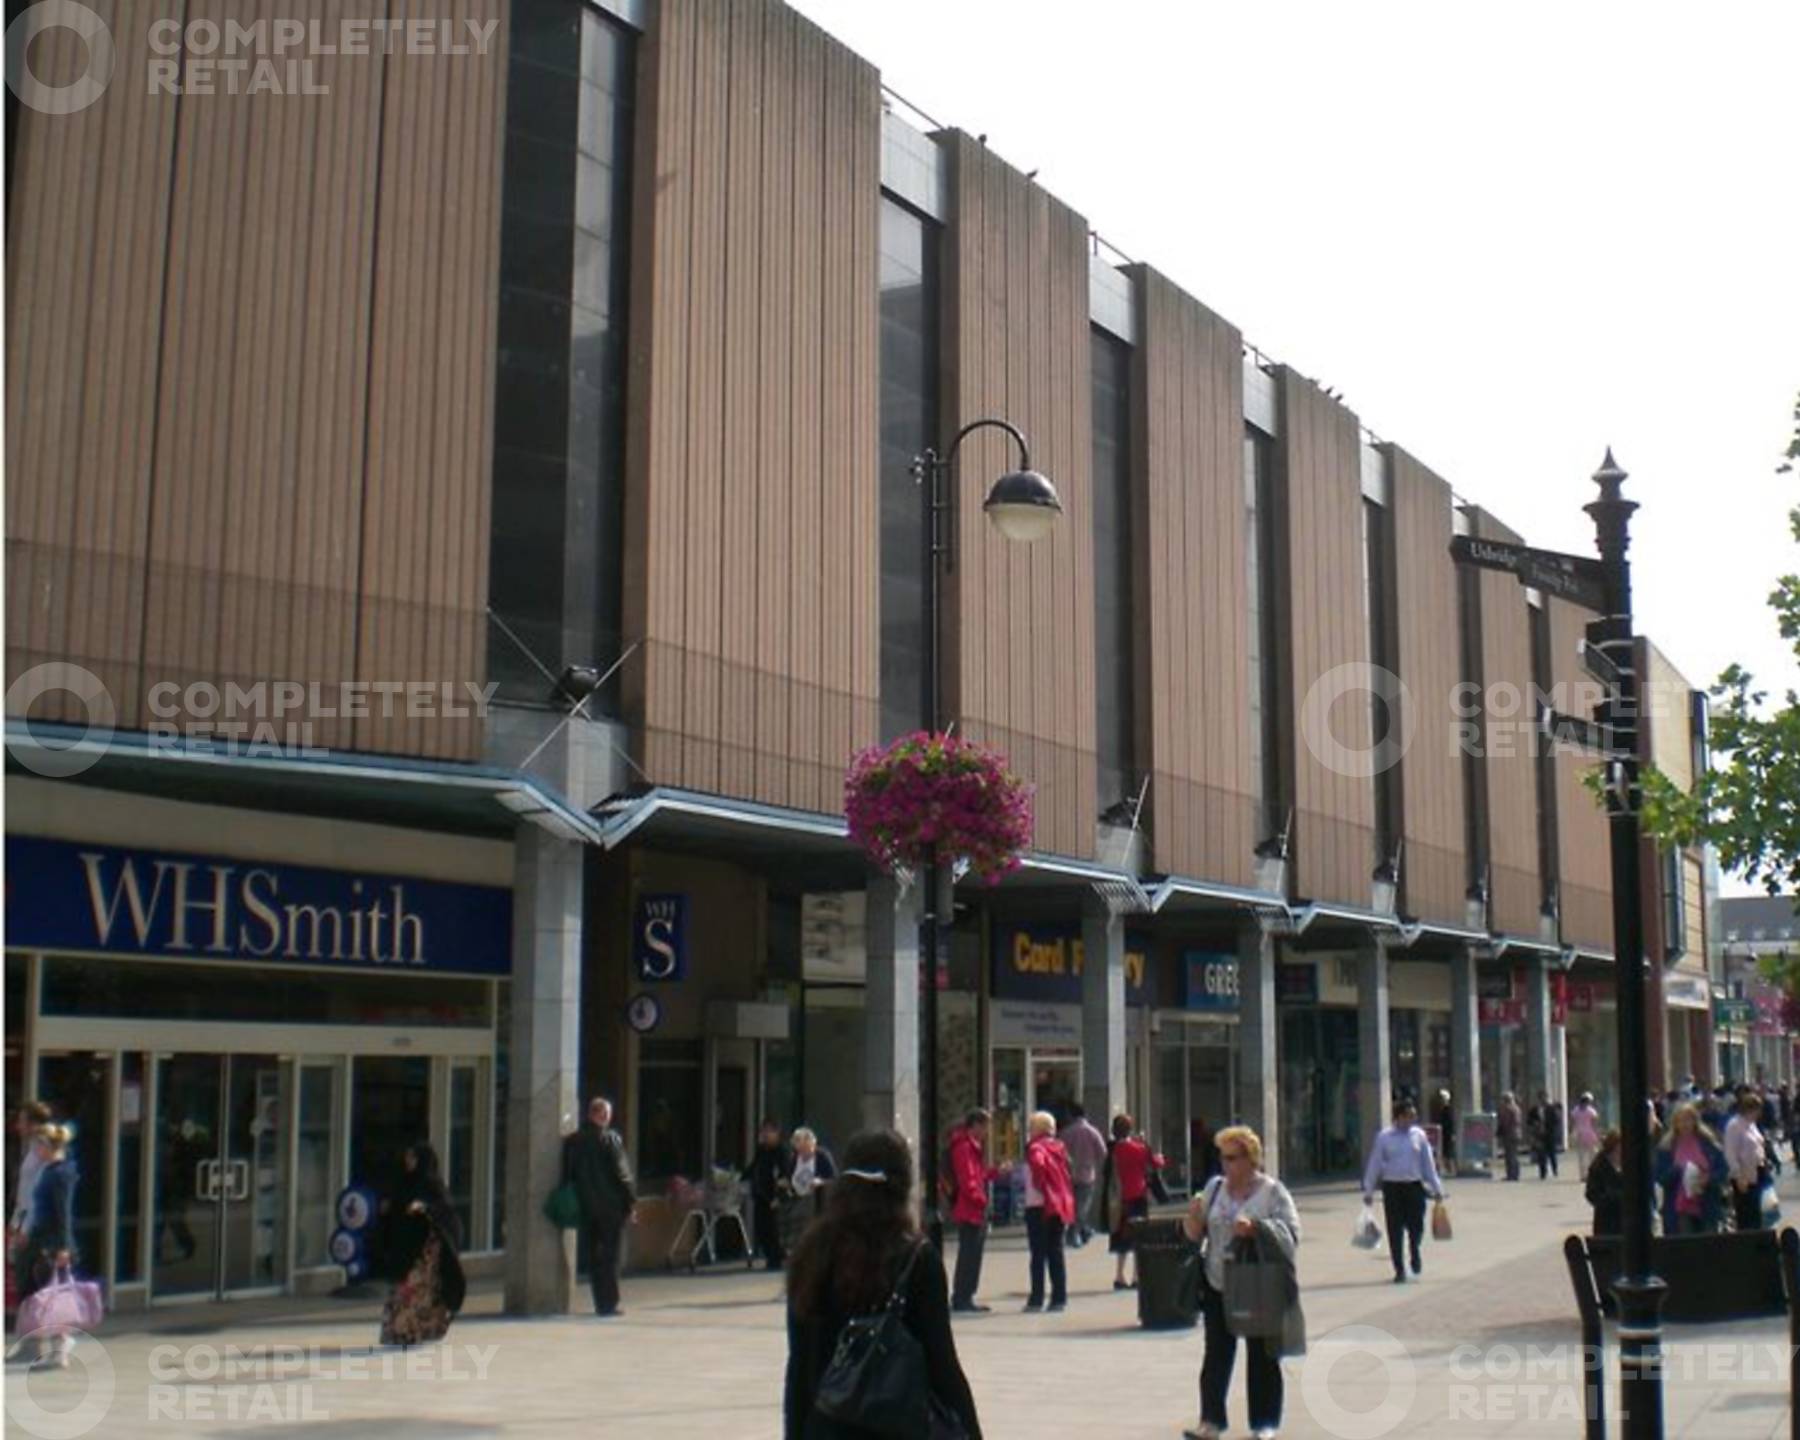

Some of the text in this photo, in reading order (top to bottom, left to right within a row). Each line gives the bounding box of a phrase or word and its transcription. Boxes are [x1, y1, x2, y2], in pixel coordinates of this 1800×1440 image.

[79, 853, 426, 964] WHSmith
[643, 918, 675, 977] S
[1013, 932, 1065, 974] Card
